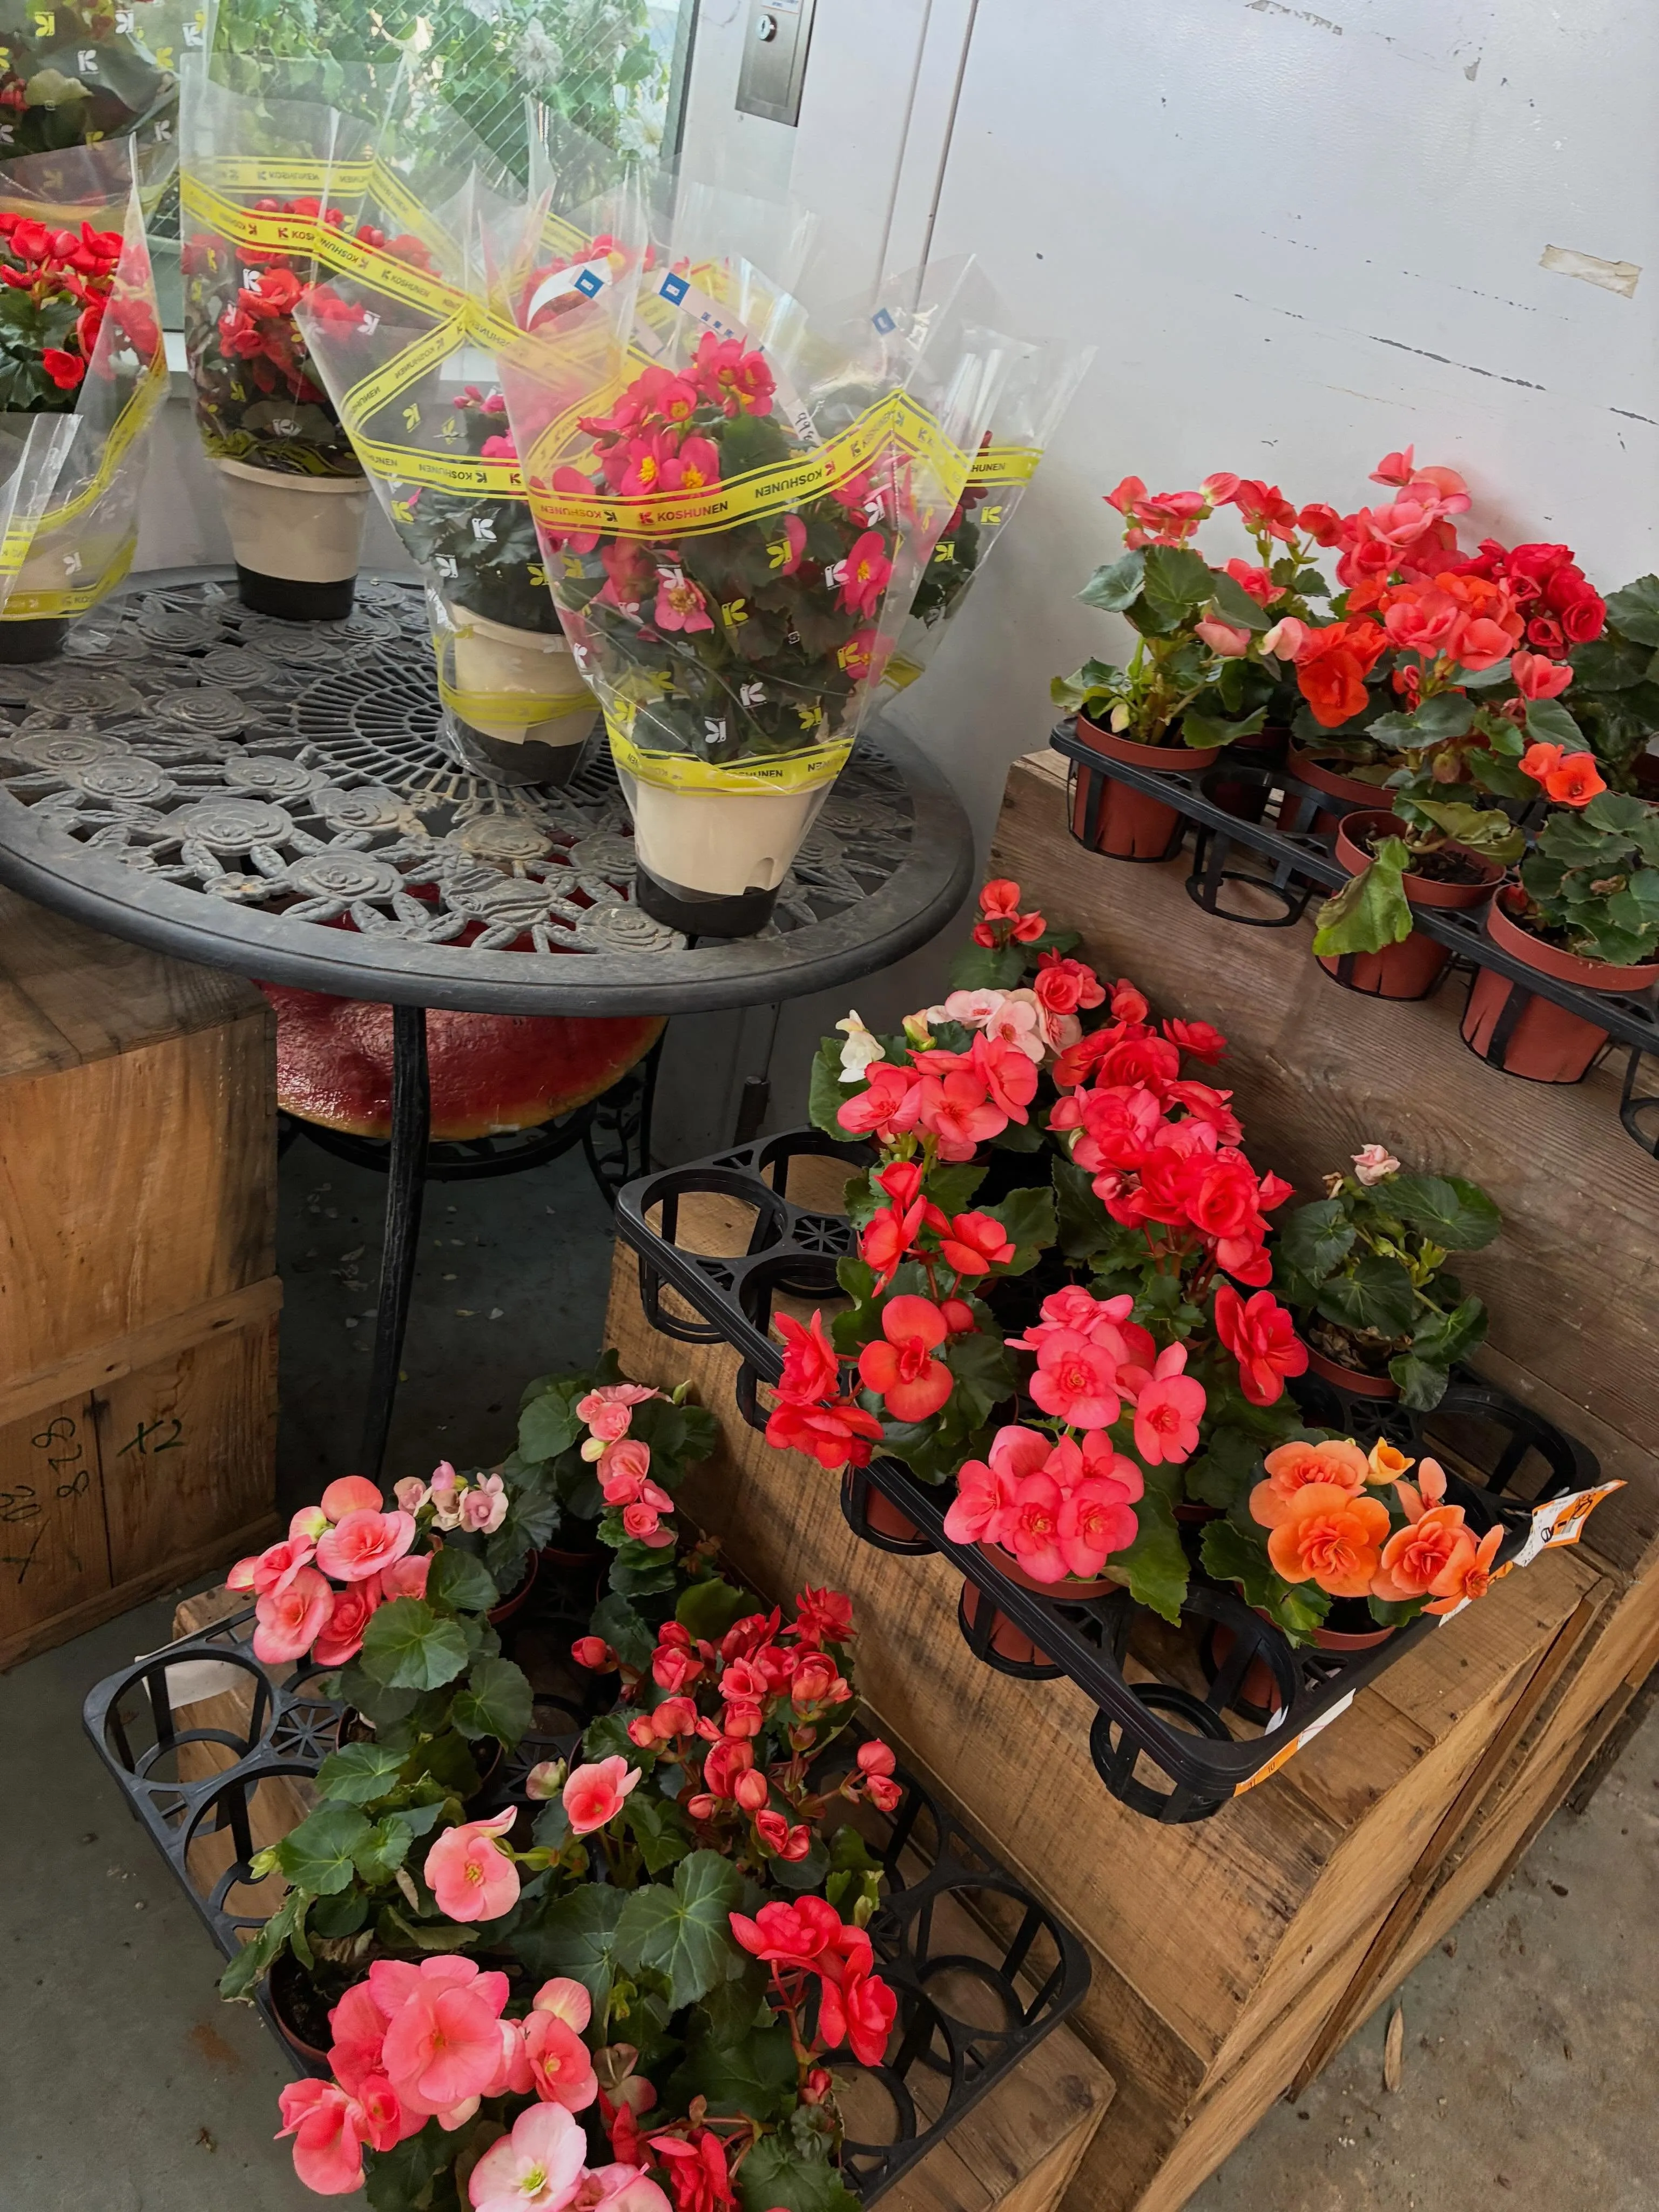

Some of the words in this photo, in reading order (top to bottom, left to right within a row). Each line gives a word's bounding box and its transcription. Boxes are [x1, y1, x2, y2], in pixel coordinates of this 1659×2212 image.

[971, 463, 1006, 472] HUNEN
[755, 468, 823, 497] KOSHUNEN
[657, 501, 729, 522] KOSHUNEN
